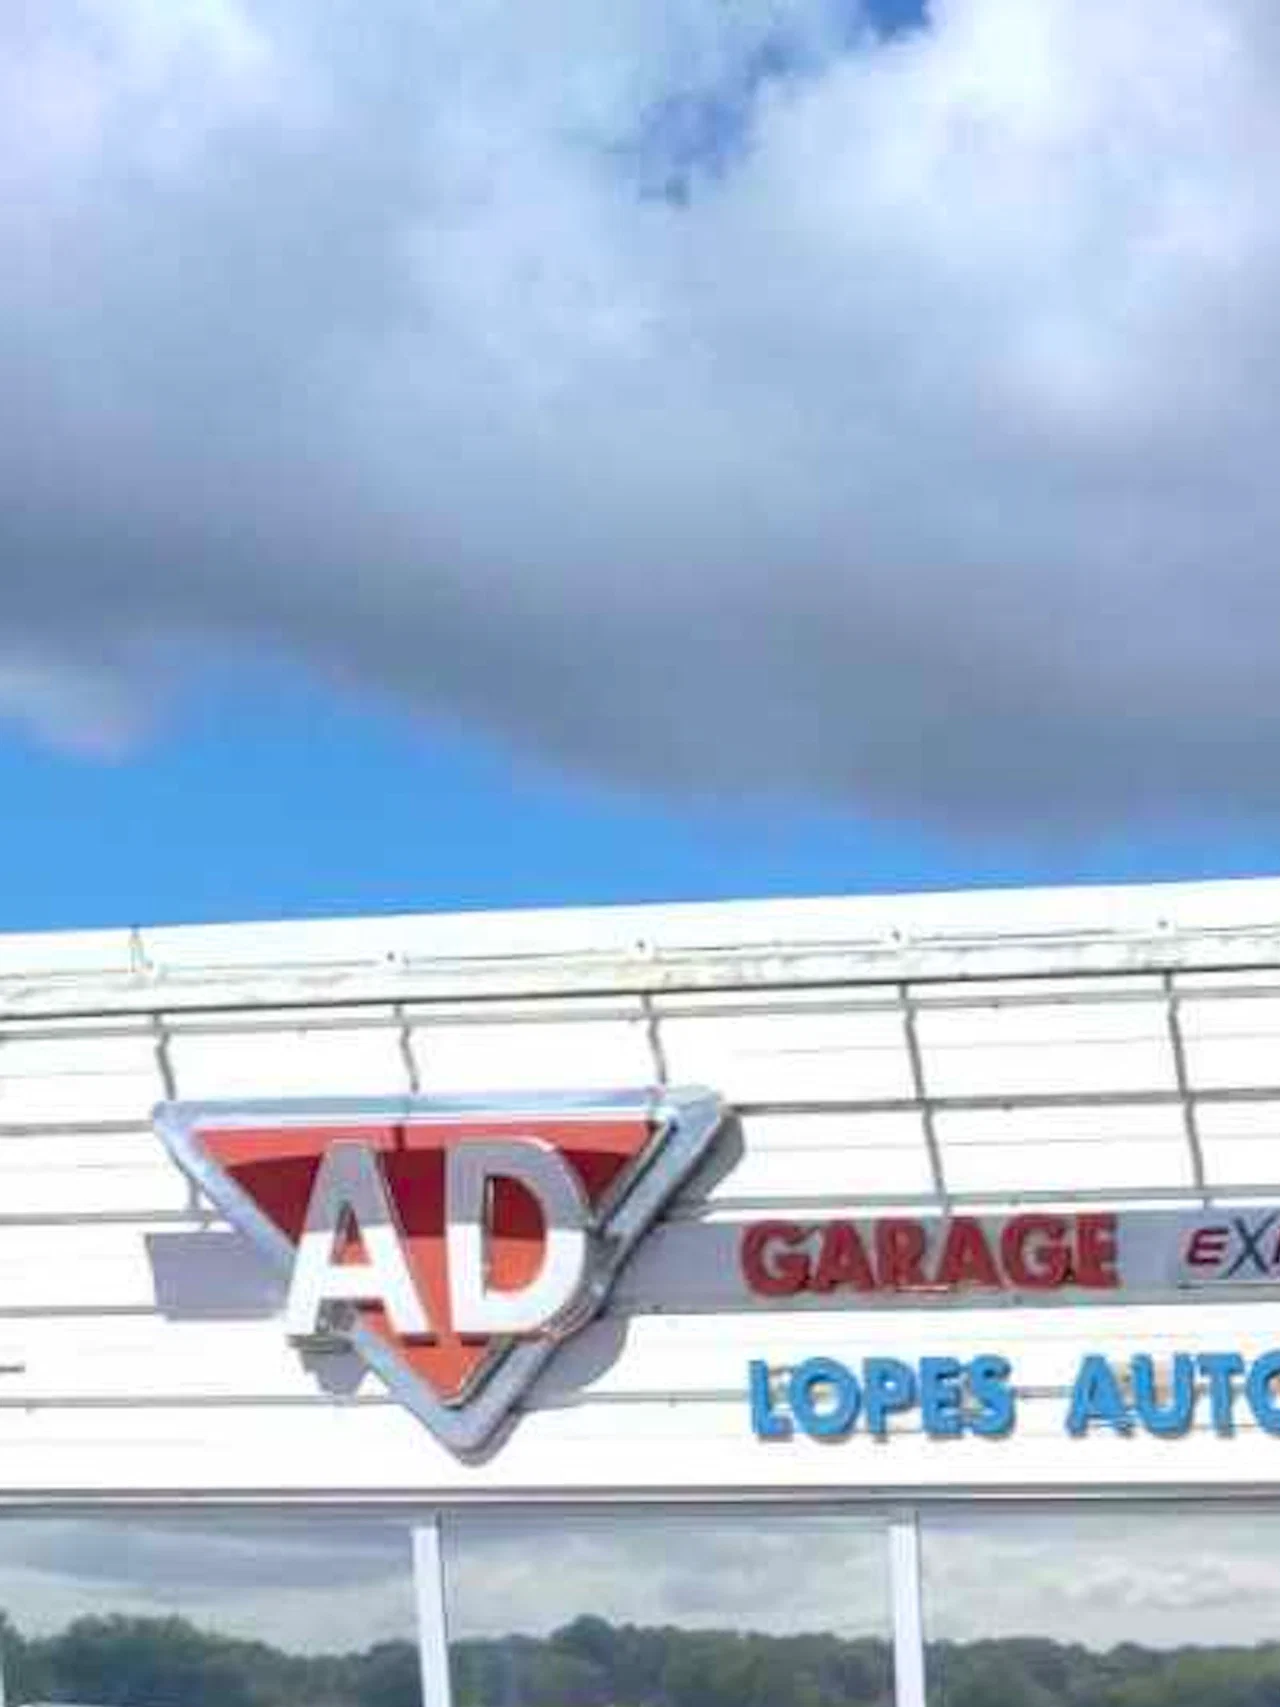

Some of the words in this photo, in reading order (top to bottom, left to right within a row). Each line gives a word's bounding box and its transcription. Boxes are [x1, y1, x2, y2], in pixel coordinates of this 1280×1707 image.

[286, 1136, 589, 1335] AD
[742, 1214, 1118, 1296] GARAGE
[749, 1356, 1012, 1438] LOPES
